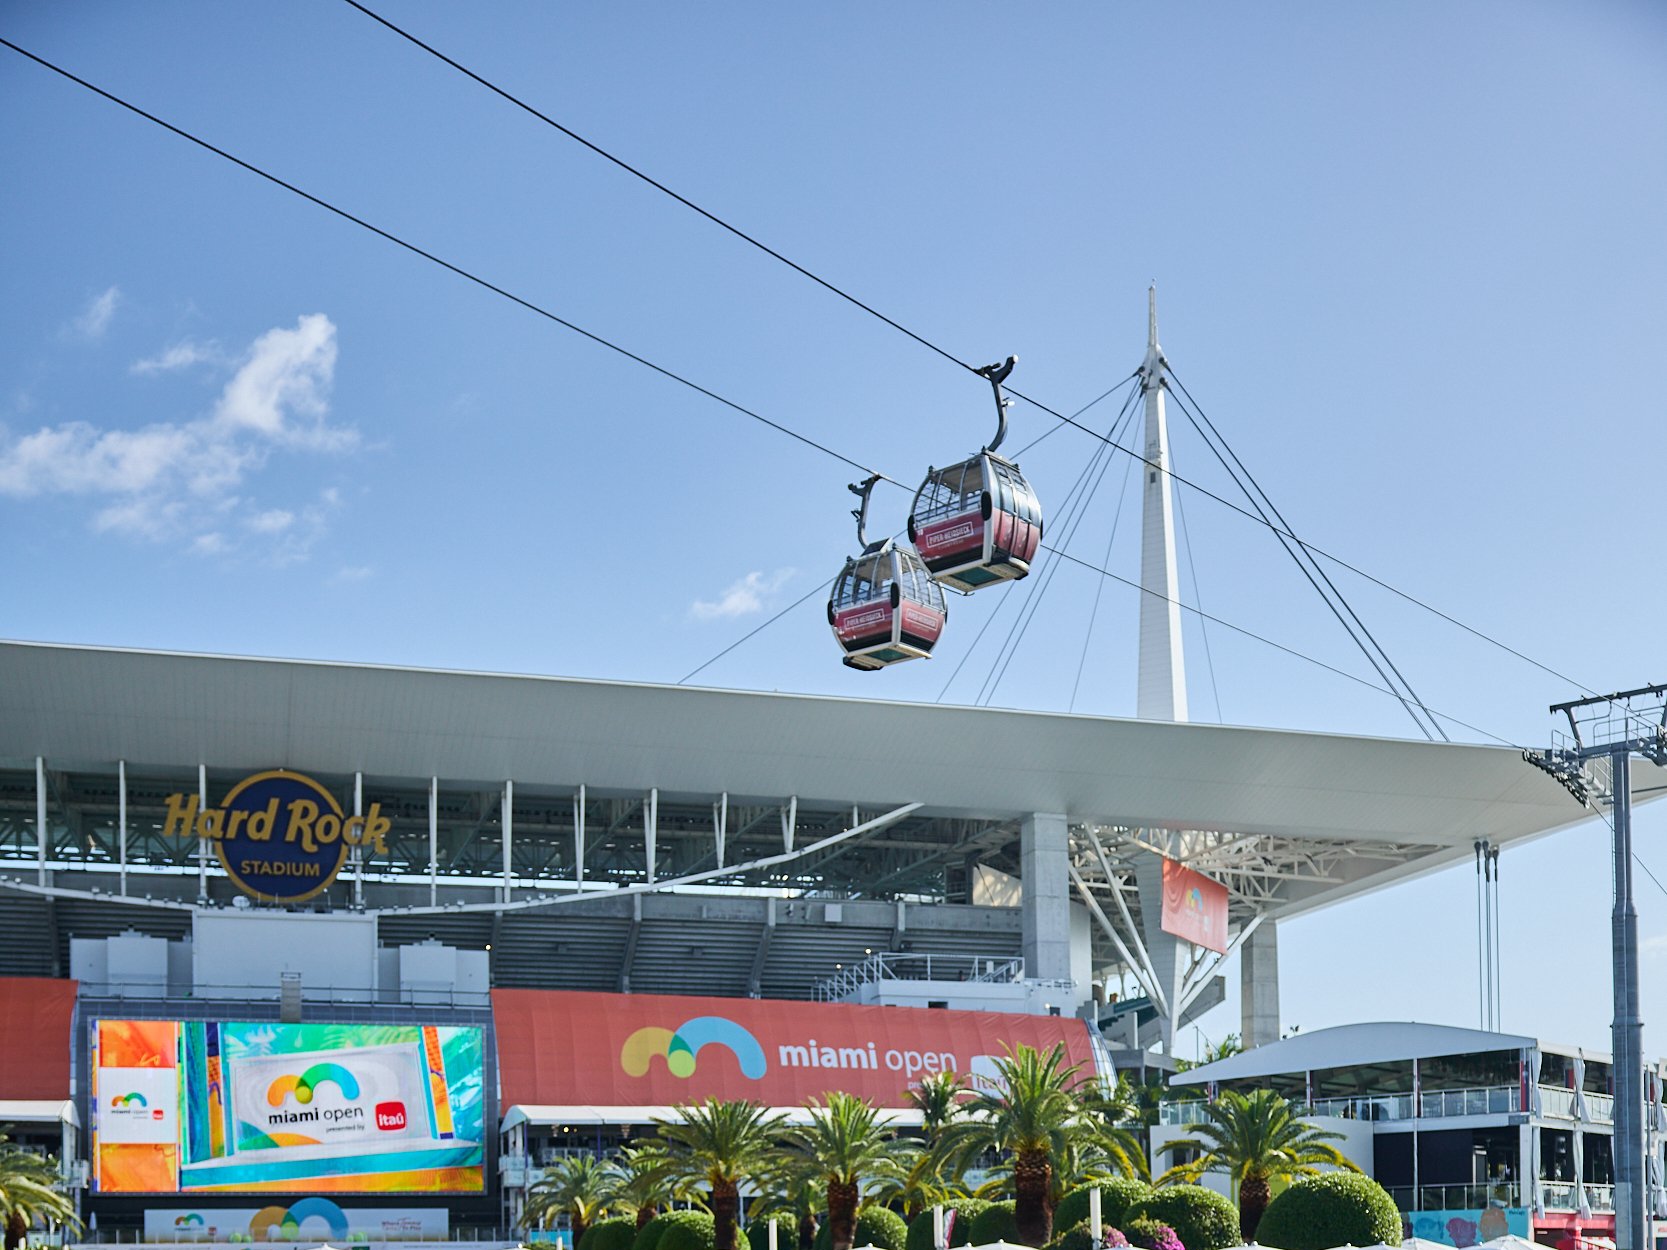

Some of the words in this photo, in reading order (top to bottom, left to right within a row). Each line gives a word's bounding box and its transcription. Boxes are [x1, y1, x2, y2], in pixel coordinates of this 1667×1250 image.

[163, 793, 280, 840] Hard
[285, 798, 392, 854] Rock
[241, 860, 320, 877] STADIUM
[778, 1039, 878, 1069] miami
[885, 1049, 957, 1078] open
[268, 1107, 319, 1125] miami
[323, 1107, 364, 1122] open
[378, 1112, 405, 1127] itaú
